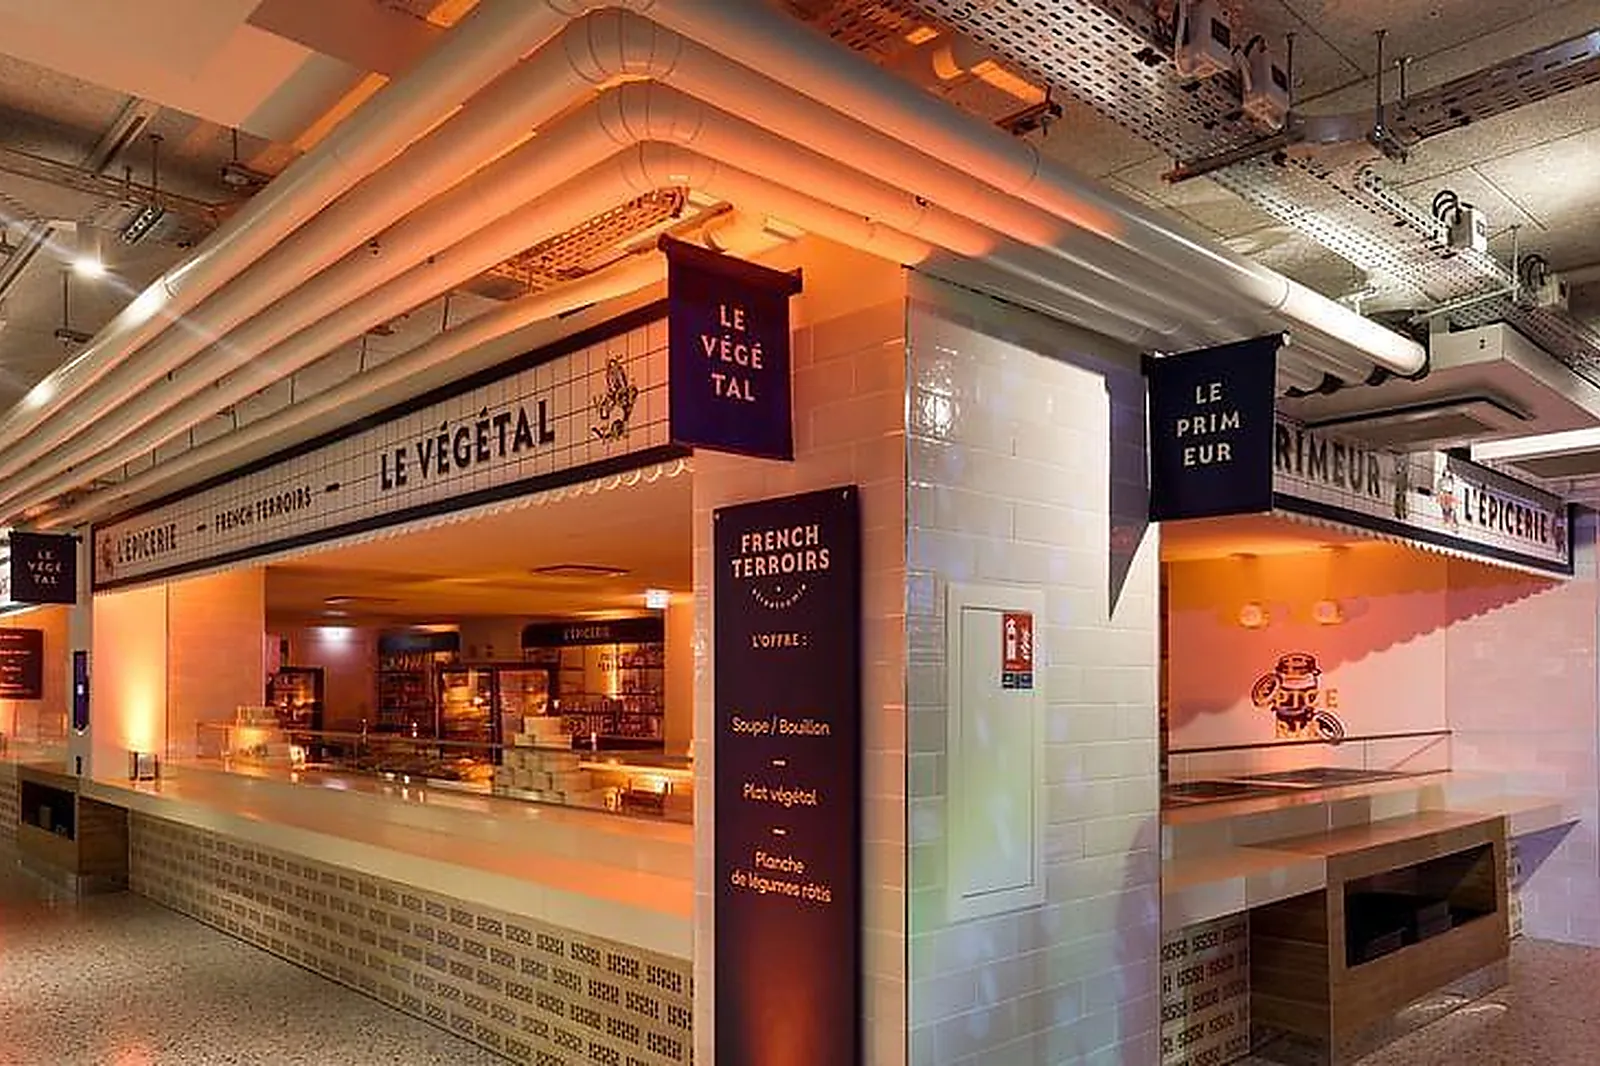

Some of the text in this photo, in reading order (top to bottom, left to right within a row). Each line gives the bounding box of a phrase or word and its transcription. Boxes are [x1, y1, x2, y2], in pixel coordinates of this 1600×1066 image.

[720, 304, 745, 331] LE
[701, 335, 763, 370] VÉGÉ
[711, 373, 756, 402] TAL
[1195, 382, 1222, 404] LE
[1177, 410, 1240, 438] PRIM
[256, 486, 312, 522] TERROIRS
[381, 448, 407, 491] LE
[416, 400, 555, 479] VÉGÉTAL
[1184, 442, 1232, 467] EUR
[1275, 421, 1381, 499] RIMEUR
[741, 524, 819, 554] FRENCH
[732, 548, 830, 578] TERROIRS
[732, 716, 770, 737] Soupe
[755, 851, 806, 874] Planche
[731, 869, 747, 887] de
